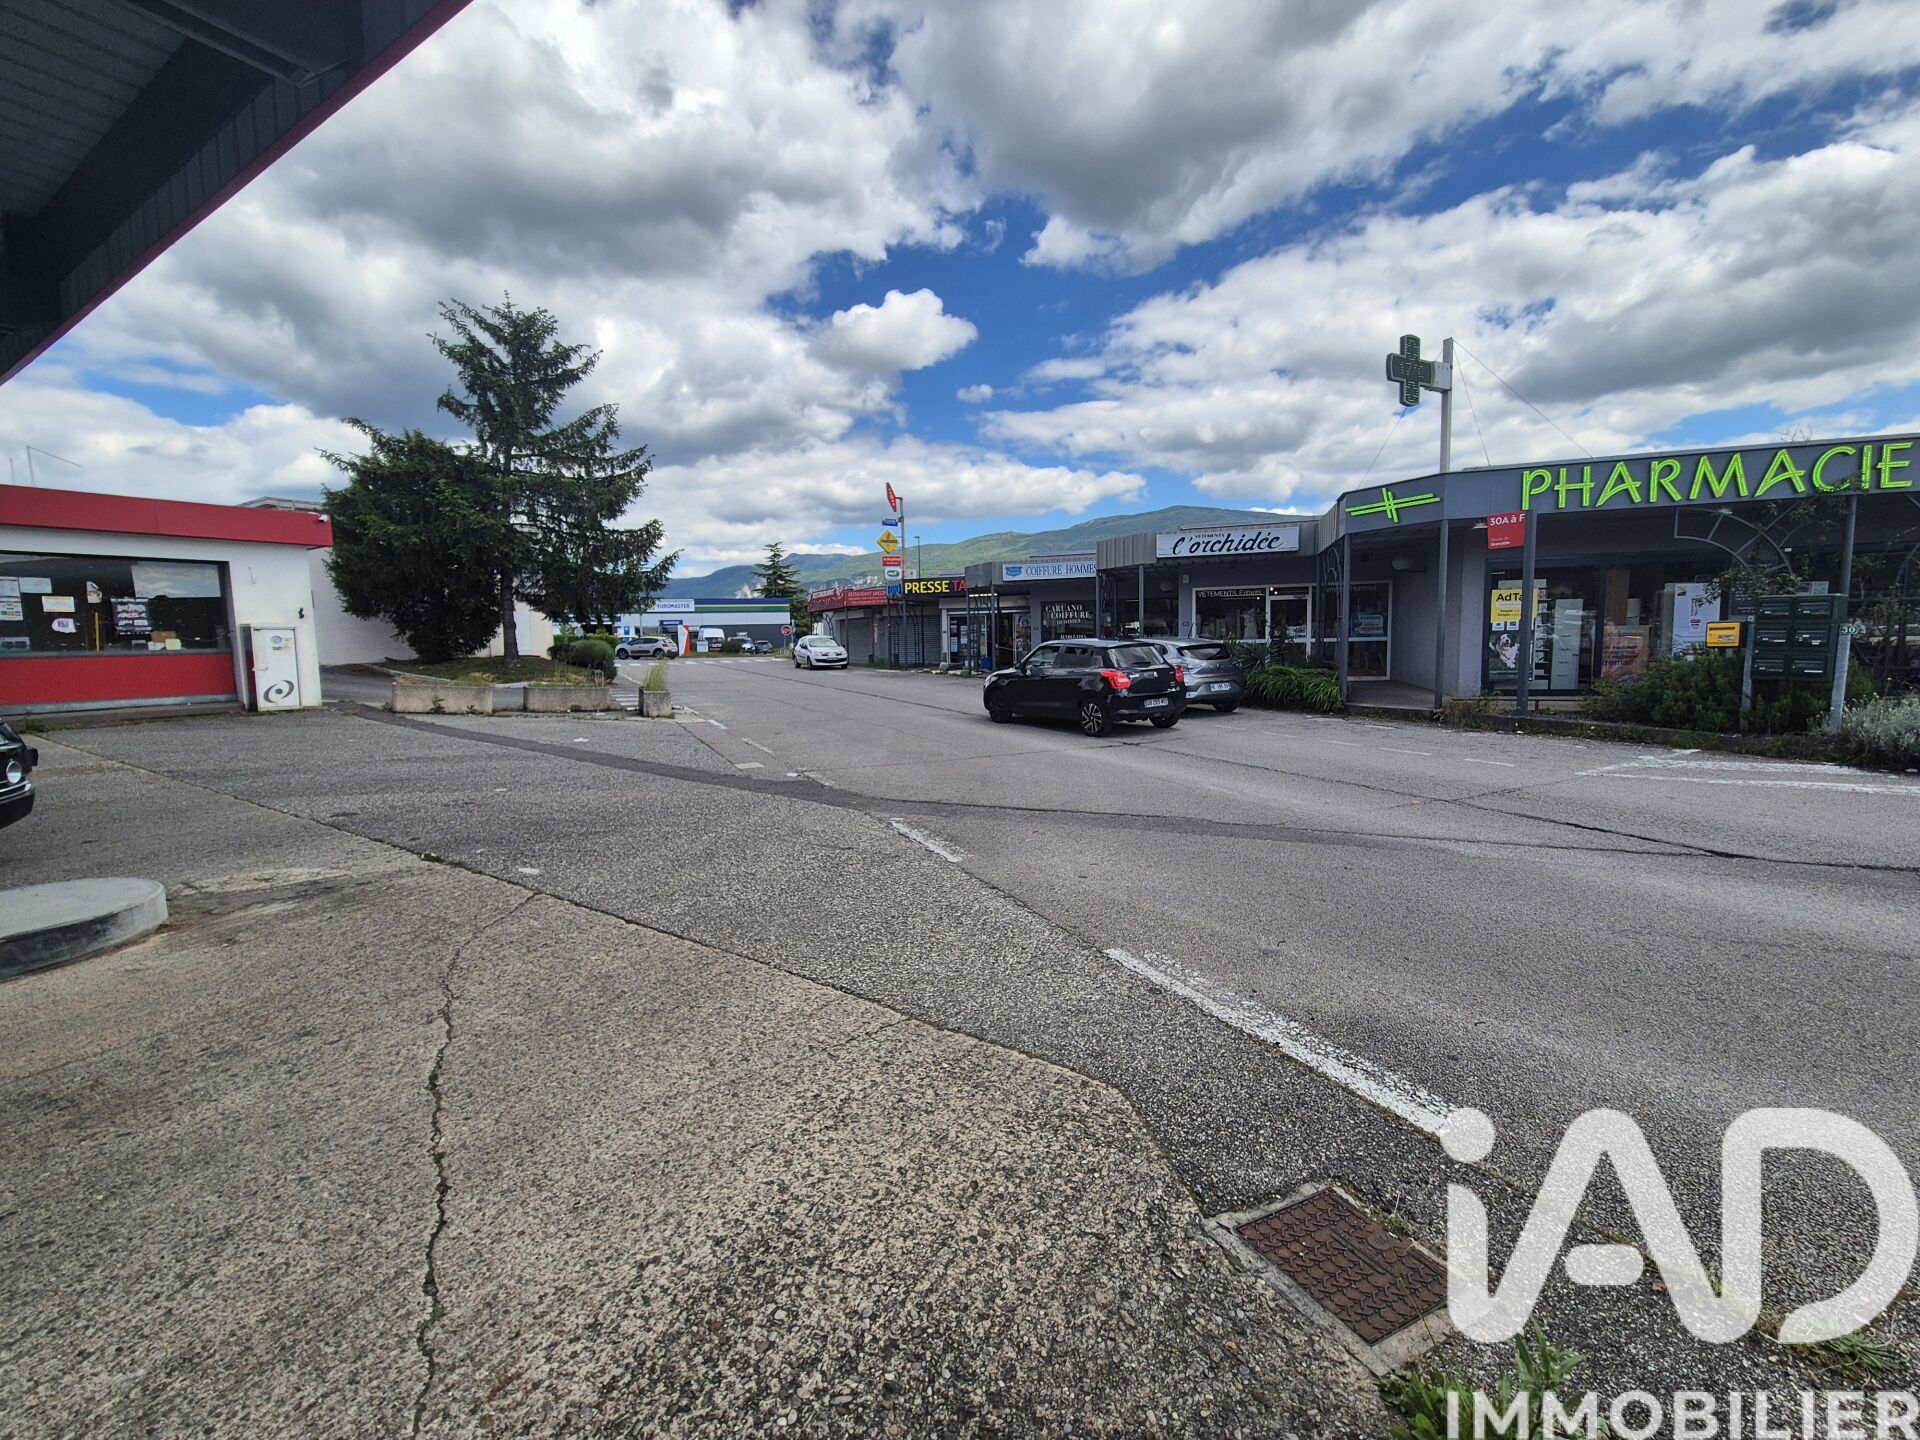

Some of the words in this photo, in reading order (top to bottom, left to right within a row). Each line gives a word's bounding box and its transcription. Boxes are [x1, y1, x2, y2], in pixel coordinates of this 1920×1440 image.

[1521, 441, 1913, 511] PHARMACIE
[1489, 516, 1509, 526] 30A
[1511, 514, 1517, 523] à
[1026, 566, 1062, 576] COIFFURE
[1065, 564, 1097, 574] HOMMES
[904, 581, 949, 593] PRESSE
[1050, 611, 1092, 619] COIFFURE
